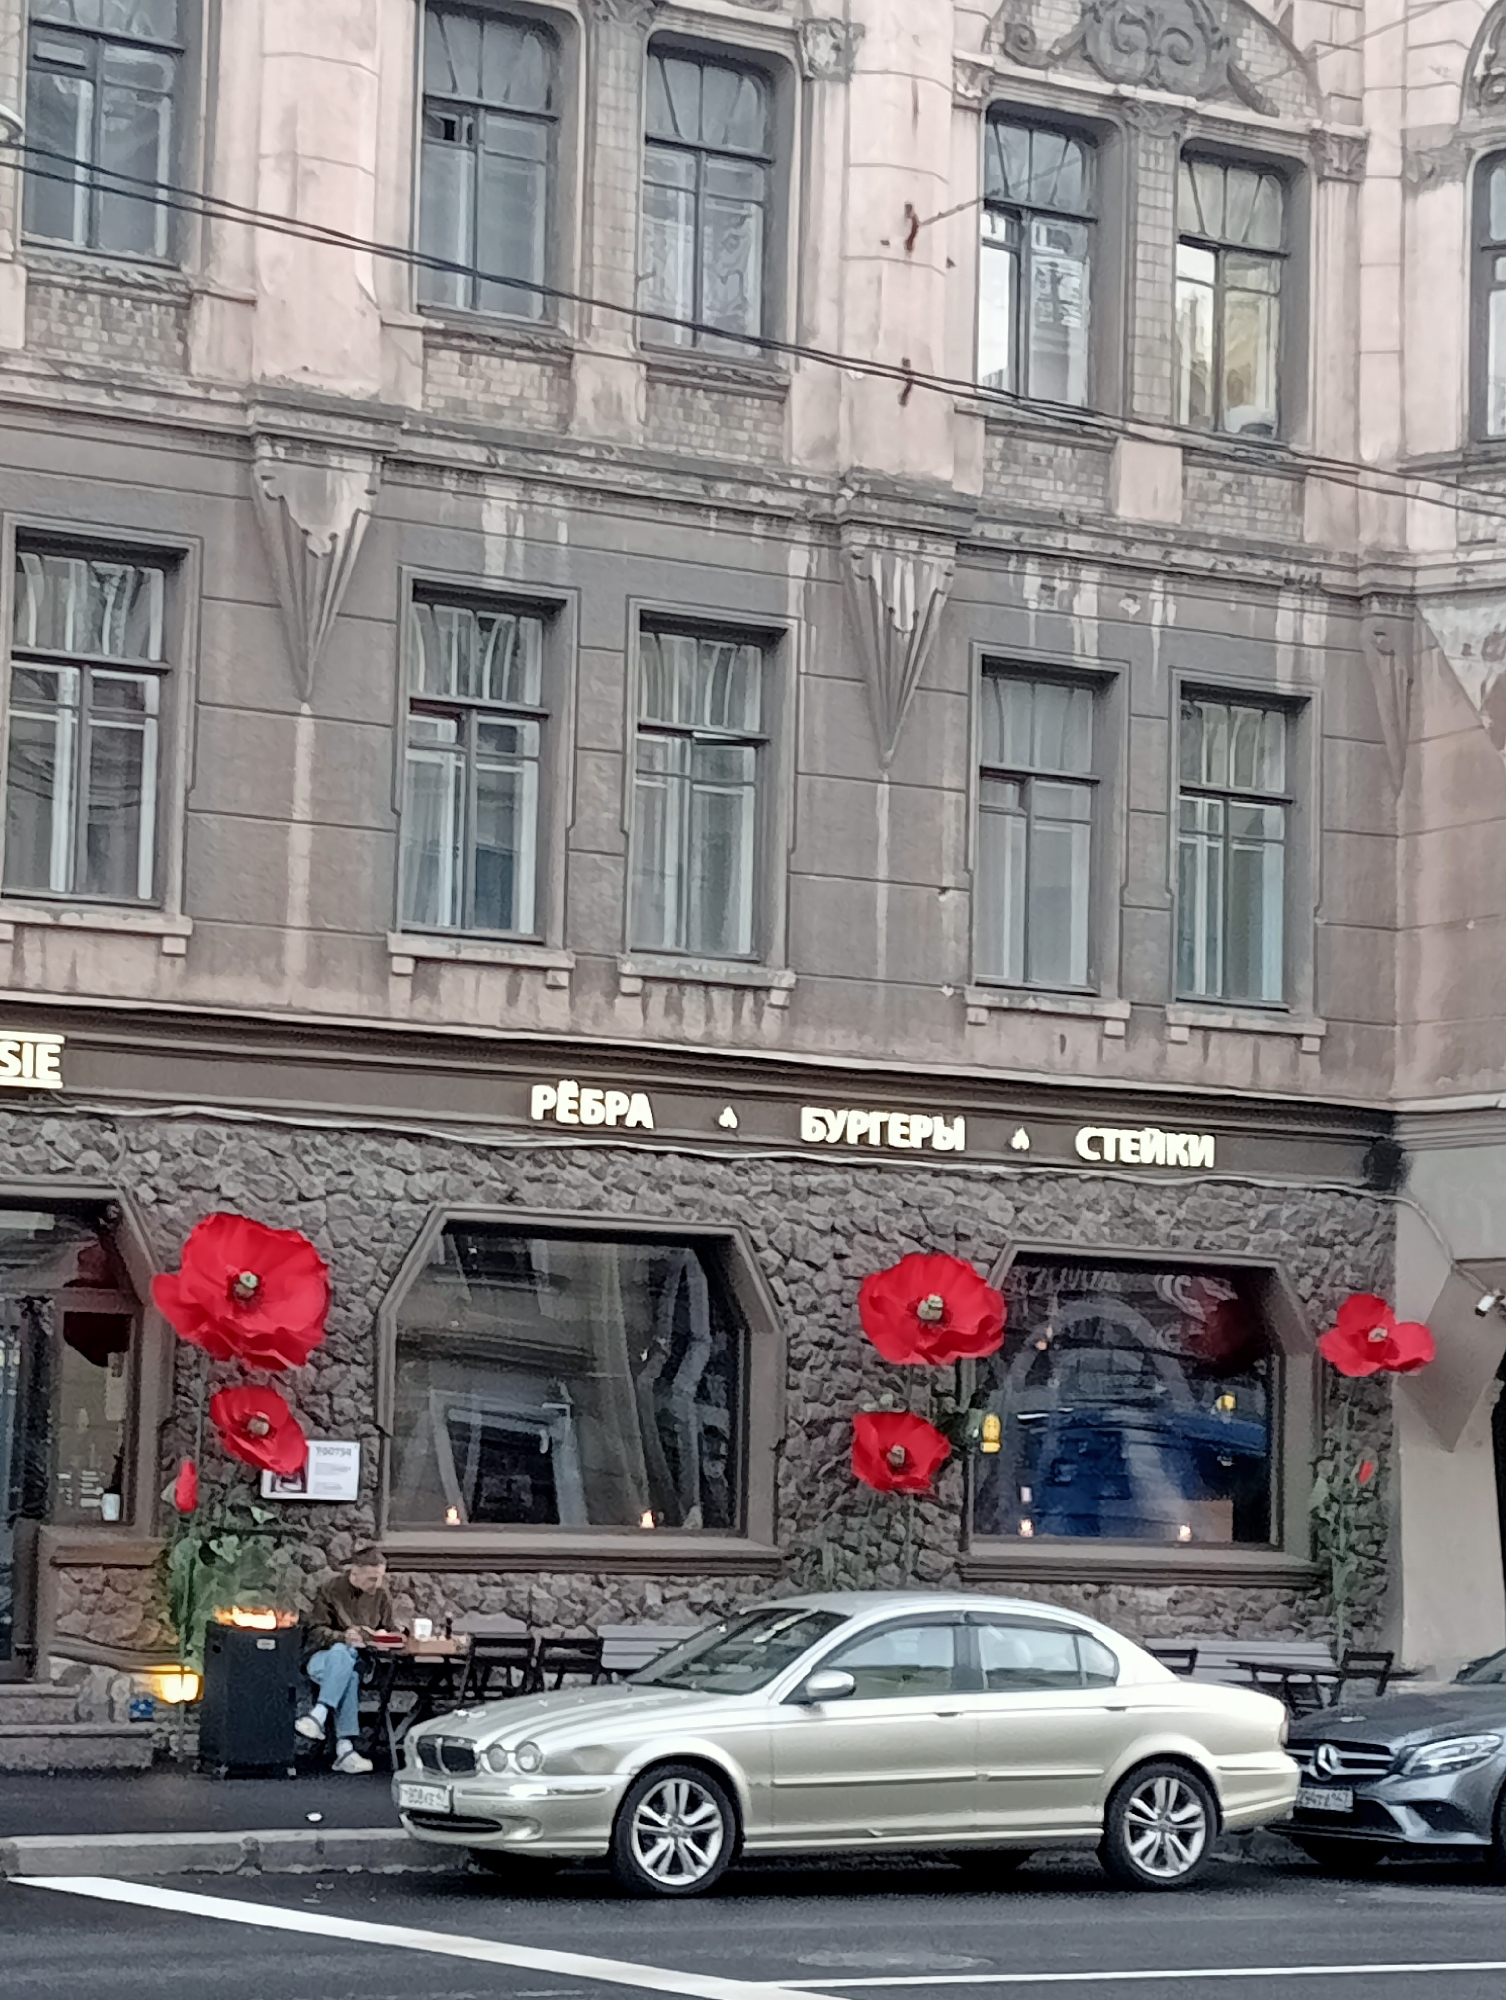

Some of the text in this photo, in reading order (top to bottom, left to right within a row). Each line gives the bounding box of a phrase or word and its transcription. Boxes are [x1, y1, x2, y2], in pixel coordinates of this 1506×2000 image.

[530, 1080, 1216, 1168] РЁБРА БУРГЕРЫ СТЕЙКИ
